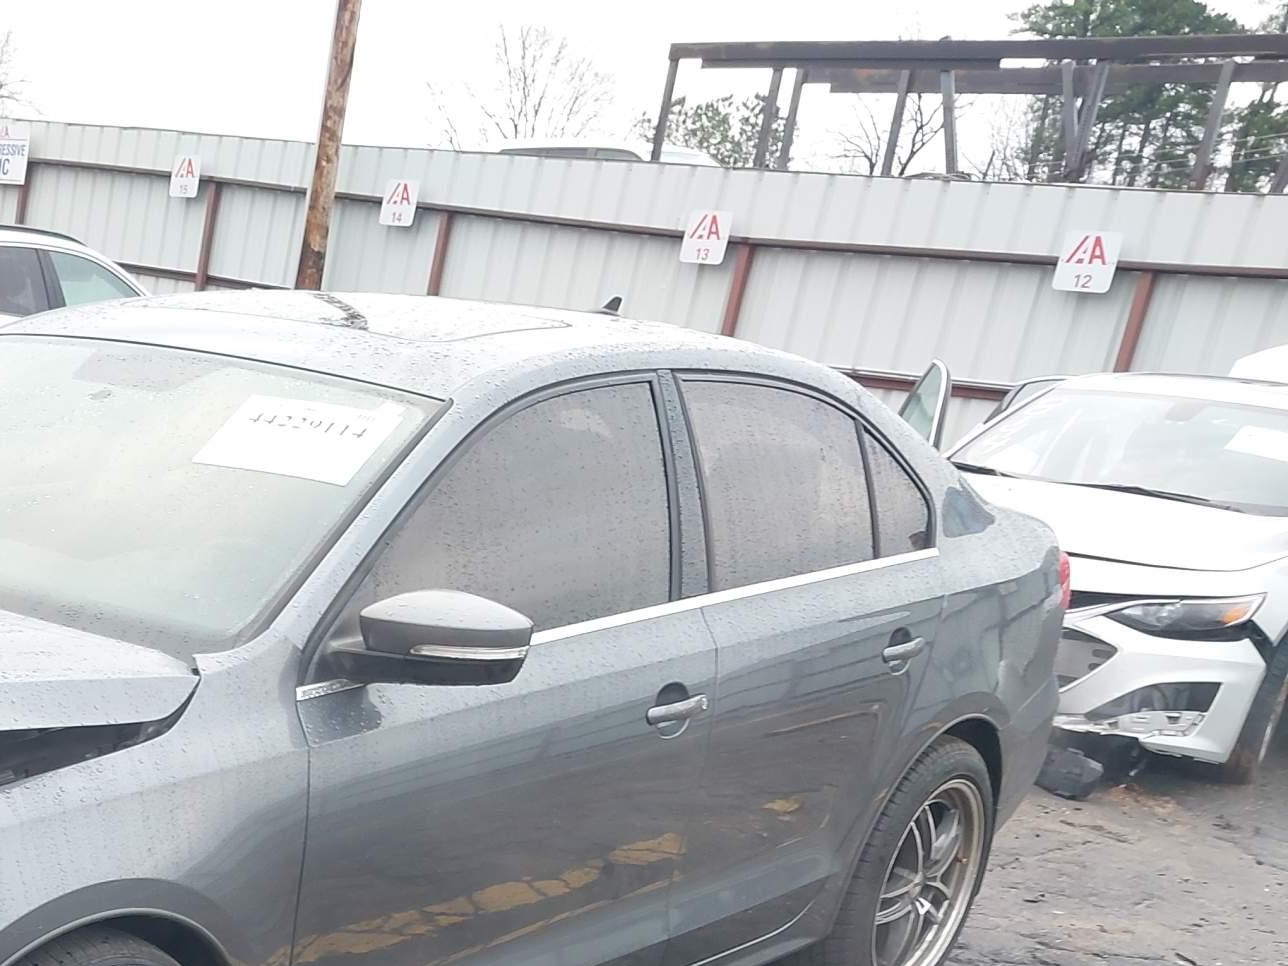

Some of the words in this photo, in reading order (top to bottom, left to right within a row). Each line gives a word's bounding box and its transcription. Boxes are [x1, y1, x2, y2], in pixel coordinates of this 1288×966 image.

[392, 212, 403, 223] 14
[696, 248, 711, 261] 13
[1073, 273, 1093, 289] 12
